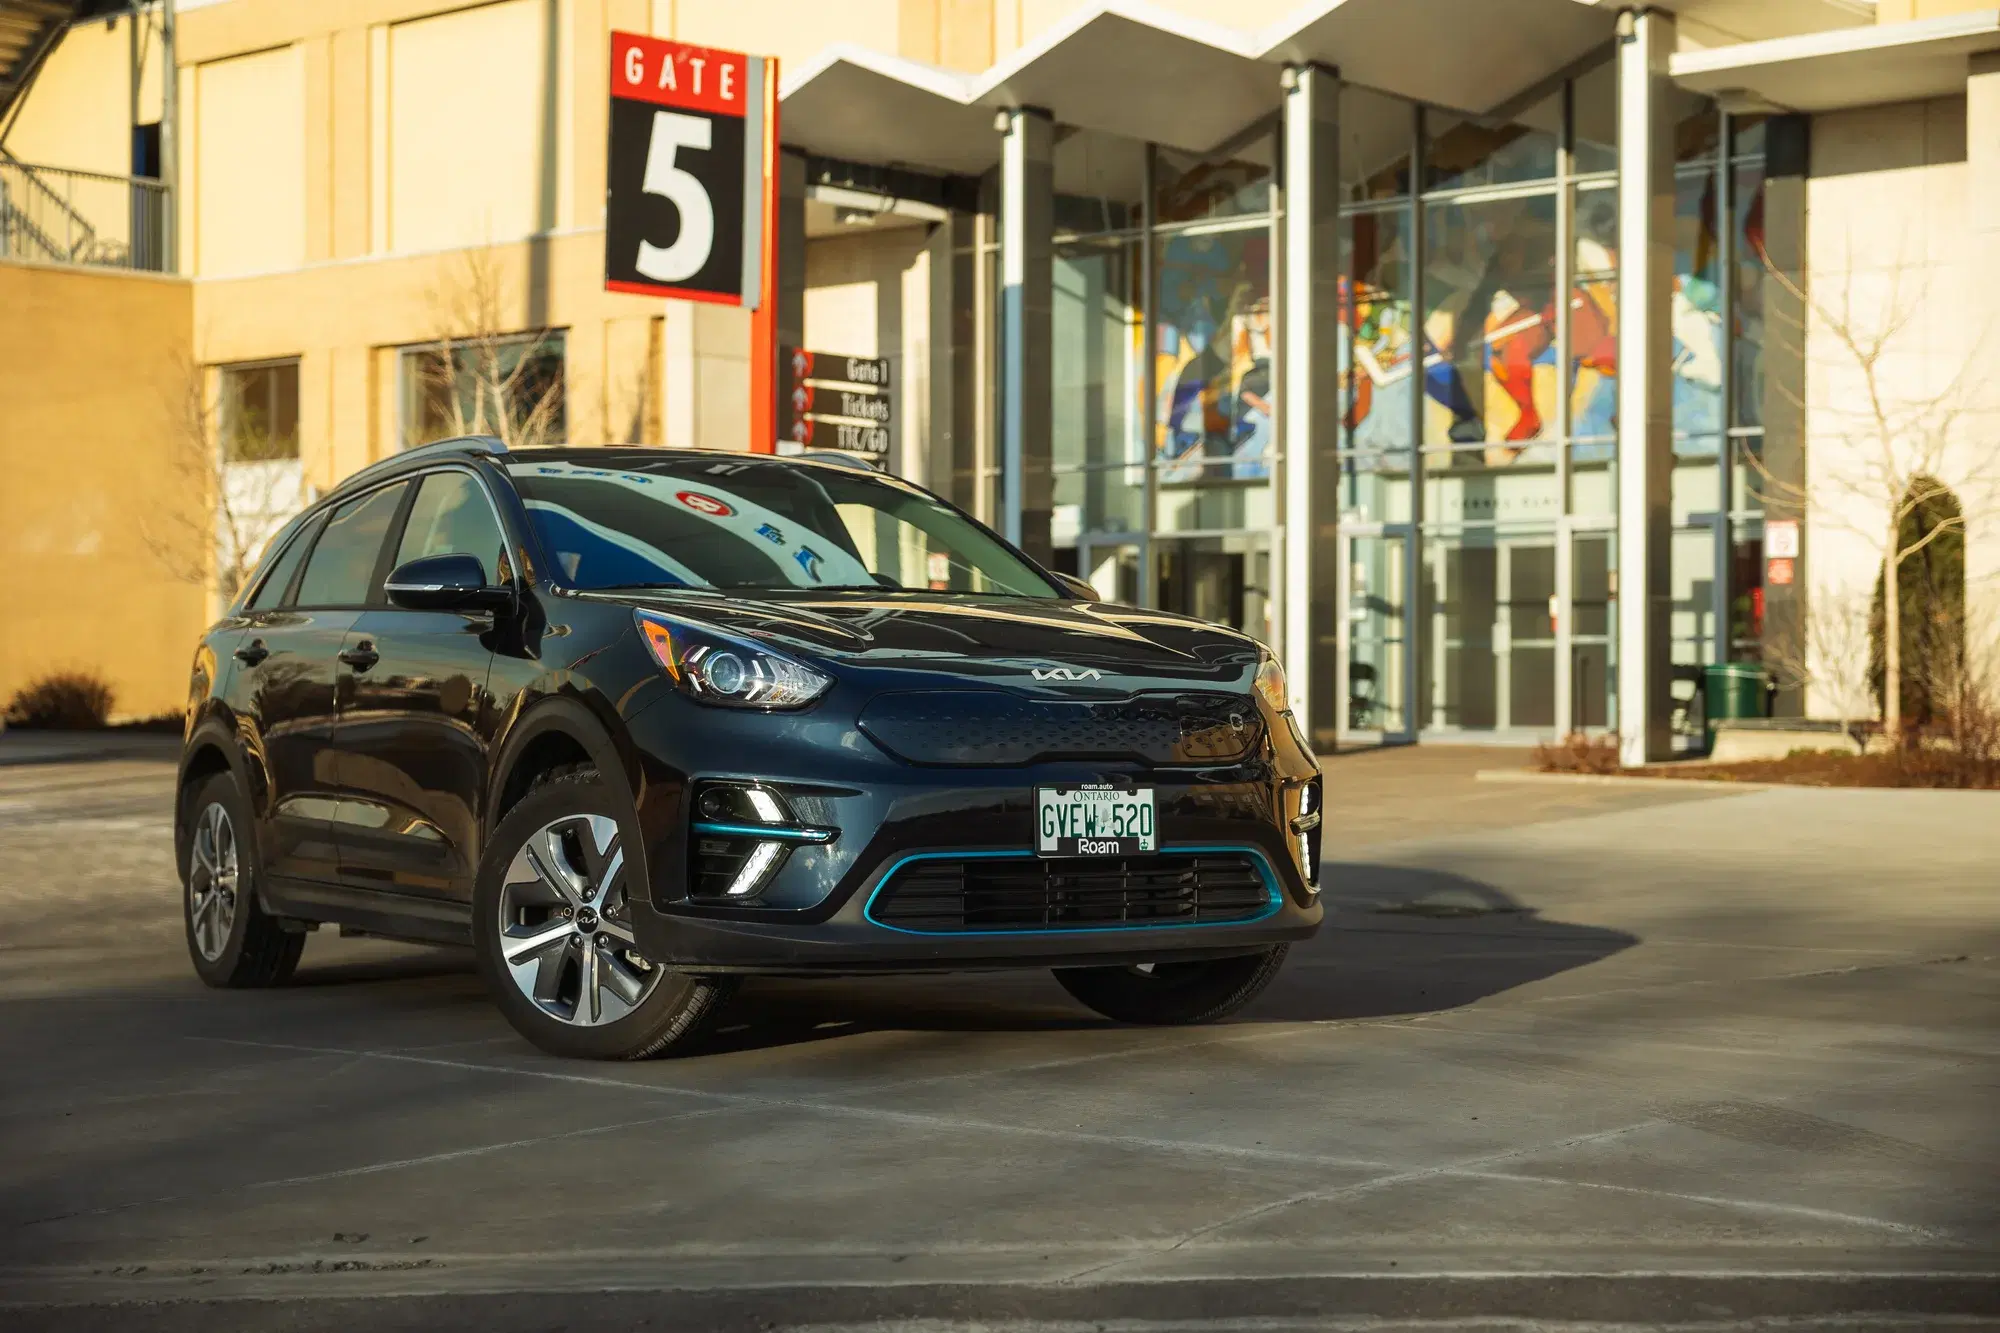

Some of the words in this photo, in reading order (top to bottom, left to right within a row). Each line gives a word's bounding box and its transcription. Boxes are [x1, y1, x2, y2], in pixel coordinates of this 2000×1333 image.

[625, 46, 735, 101] GATE
[635, 110, 714, 282] 5
[846, 358, 879, 383] Gate
[841, 392, 889, 421] Tickets
[1031, 668, 1102, 682] KIA
[1042, 803, 1096, 838] GVEW
[1112, 803, 1153, 837] 520
[1078, 838, 1120, 854] Roam
